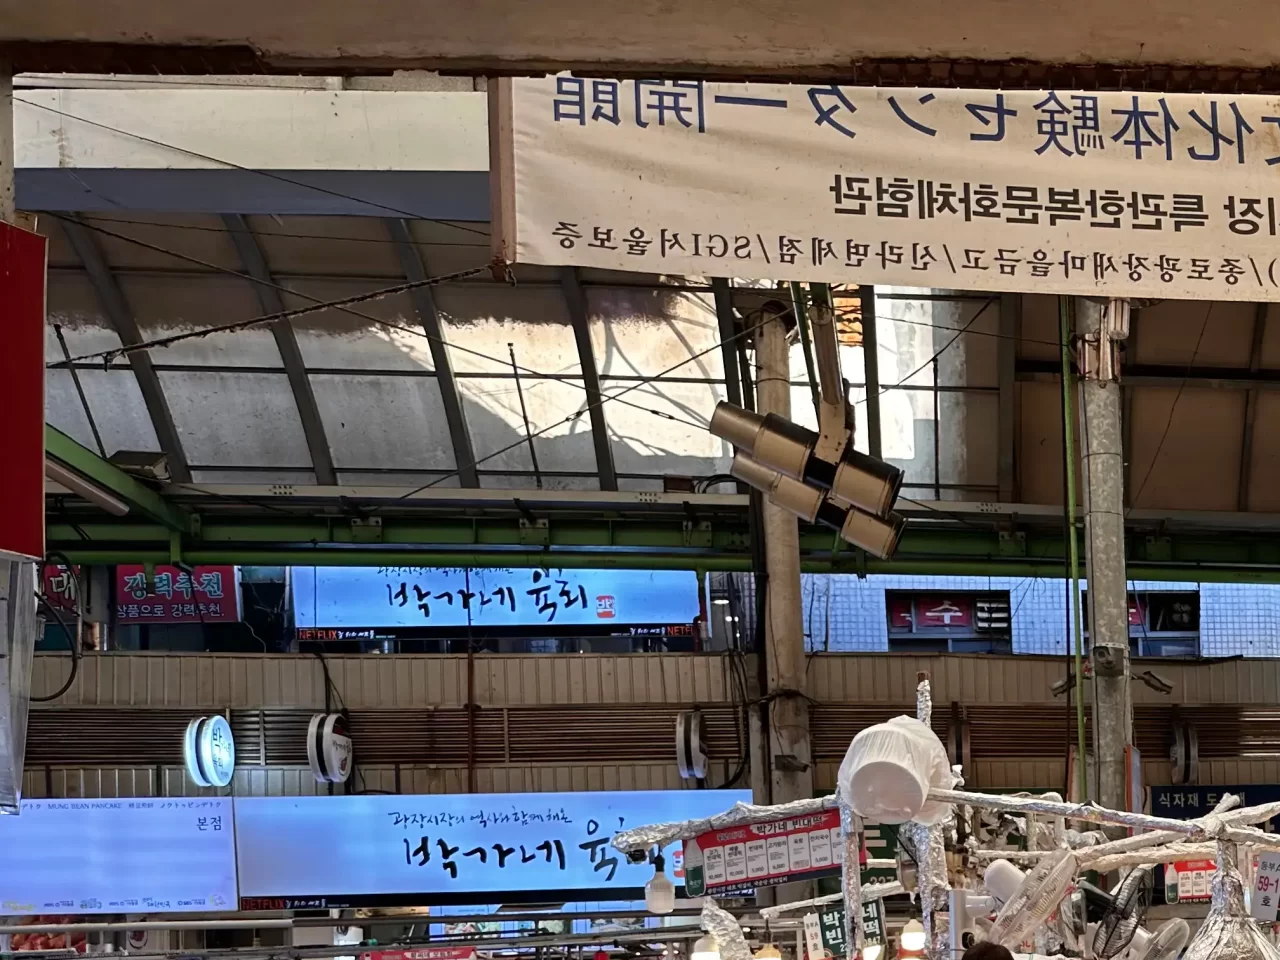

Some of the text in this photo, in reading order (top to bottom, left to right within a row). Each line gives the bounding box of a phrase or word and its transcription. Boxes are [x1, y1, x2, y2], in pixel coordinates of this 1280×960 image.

[124, 572, 224, 600] 강력추천
[299, 630, 337, 640] NETFLIX
[1159, 791, 1199, 807] 식자재
[196, 815, 222, 831] 본점
[757, 820, 788, 836] 박가네
[1257, 875, 1280, 893] 59-1
[242, 899, 285, 911] NETFLIX
[1260, 895, 1272, 907] 호
[823, 901, 878, 928] 박네
[826, 920, 880, 945] 빈떡
